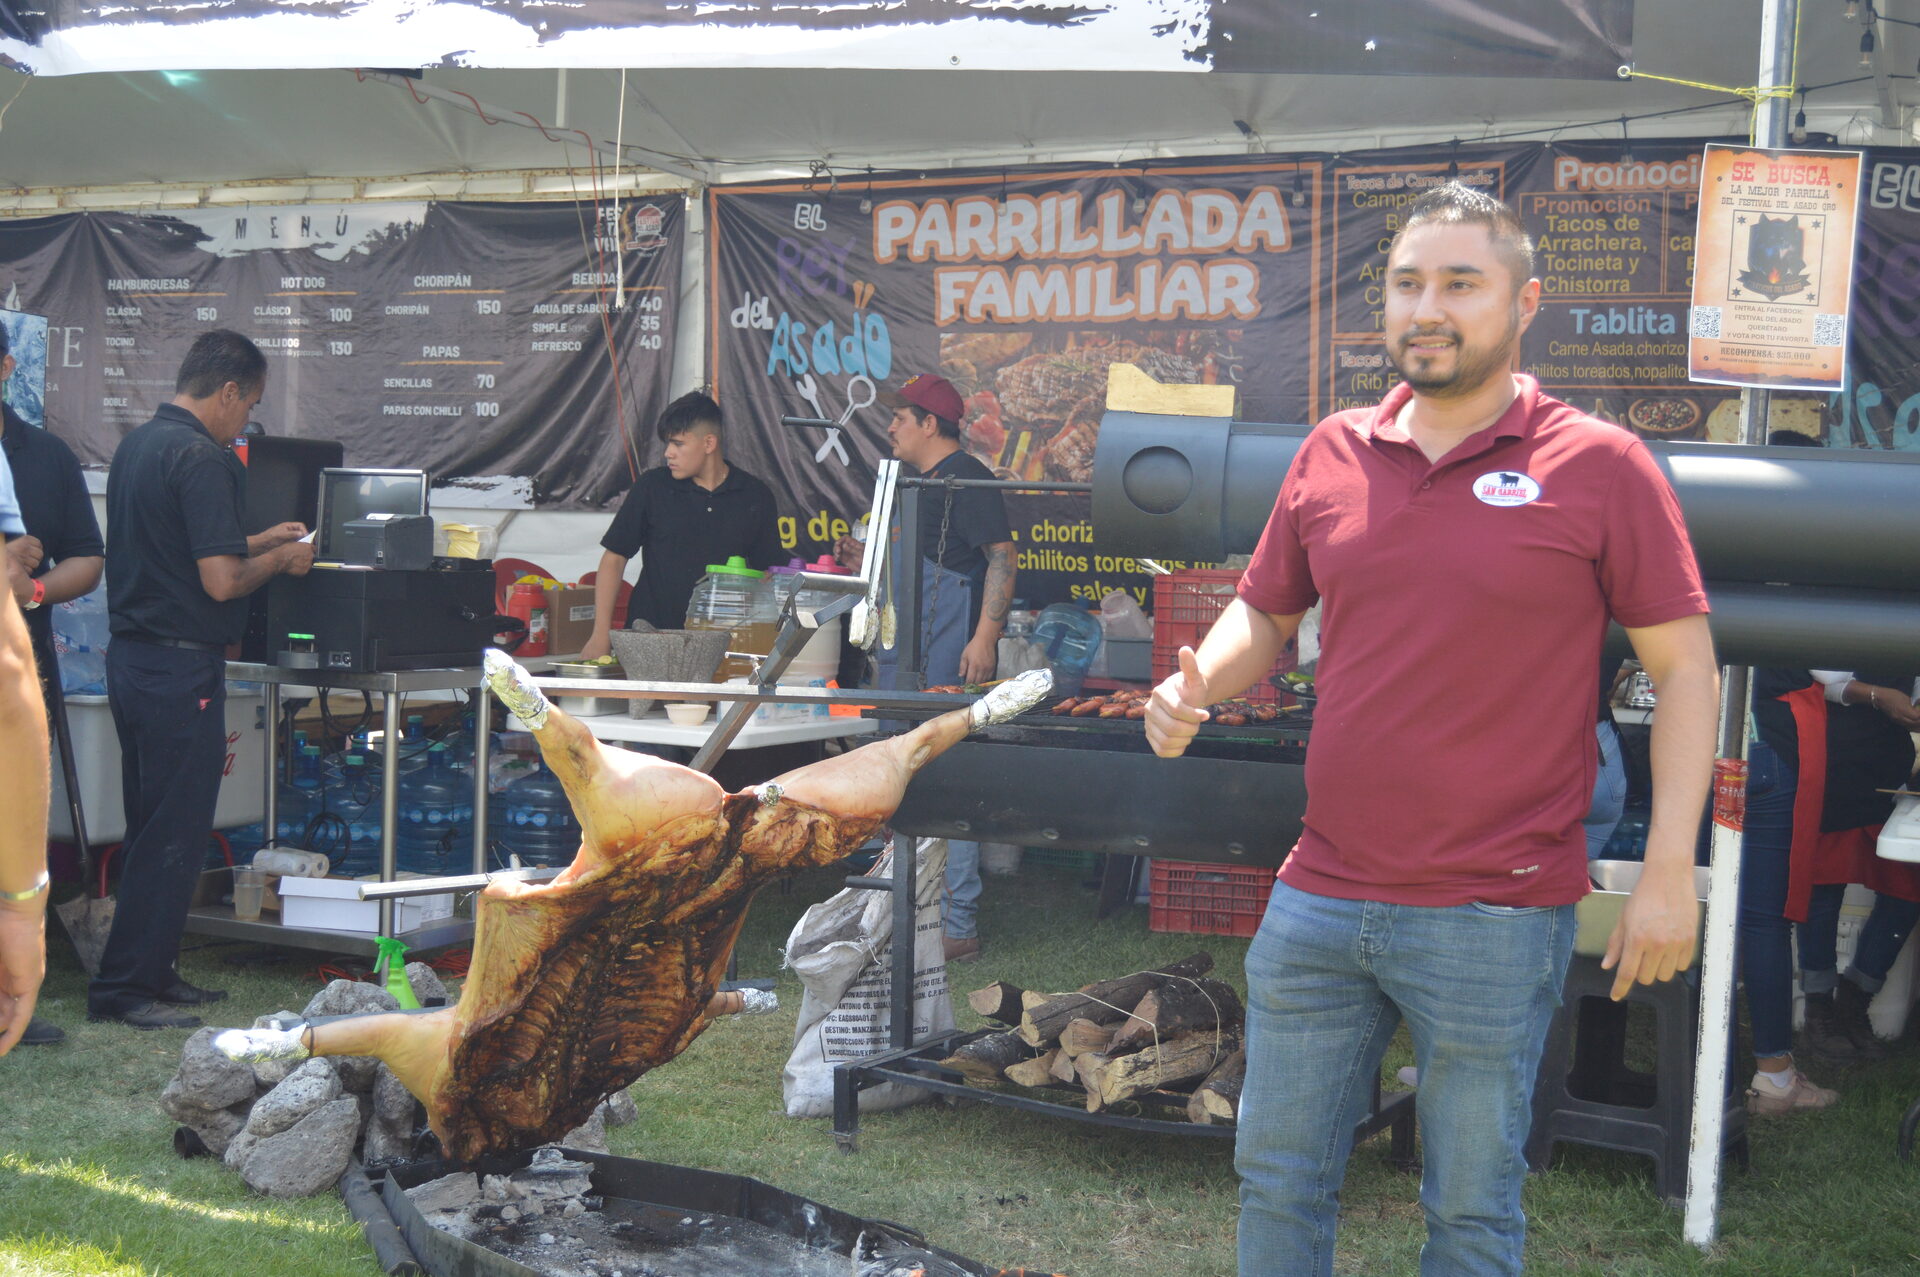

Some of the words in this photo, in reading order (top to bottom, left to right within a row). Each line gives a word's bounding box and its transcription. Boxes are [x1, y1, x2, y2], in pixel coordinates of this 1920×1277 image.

[1346, 175, 1386, 190] Tacos
[1387, 173, 1404, 188] de
[1406, 173, 1446, 188] Carne
[1732, 161, 1756, 182] SE
[1768, 164, 1831, 187] BUSCA
[1730, 185, 1742, 195] LA
[1748, 186, 1780, 197] MEJOR
[1785, 188, 1830, 200] PARRILLA
[1533, 194, 1651, 215] Promoción
[1721, 196, 1735, 206] DEL
[1738, 198, 1772, 208] FESTIVAL
[1776, 200, 1790, 209] DEL
[1793, 201, 1818, 210] ASADO
[794, 203, 827, 231] EL
[875, 188, 1289, 261] PARRILLADA
[1545, 214, 1608, 233] Tacos
[1614, 213, 1641, 232] de
[1536, 234, 1648, 253] Arrachera,
[1544, 253, 1624, 272] Tocineta
[1628, 257, 1640, 276] y
[107, 278, 191, 291] HAMBURGUESAS
[281, 277, 303, 289] HOT
[303, 277, 326, 289] DOG
[413, 272, 472, 287] CHORIPÁN
[1543, 275, 1631, 293] Chistorra
[936, 258, 1260, 325] FAMILIAR
[106, 305, 143, 316] CLÁSICA
[253, 304, 292, 316] CLÁSICO
[385, 304, 430, 315] CHORIPÁN
[532, 304, 561, 314] AGUA
[562, 304, 575, 314] DE
[576, 303, 611, 314] SABOR
[1734, 304, 1756, 312] ENTRA
[1569, 306, 1676, 335] Tablita
[1734, 314, 1764, 322] FESTIVAL
[532, 323, 567, 333] SIMPLE
[105, 337, 136, 347] TOCINO
[252, 338, 281, 348] CHILLI
[281, 338, 301, 348] DOG
[1732, 332, 1750, 340] VOTA
[1776, 335, 1809, 343] FAVORITA
[422, 345, 461, 358] PAPAS
[531, 341, 582, 351] REFRESCO
[1548, 341, 1589, 357] Carne
[1720, 347, 1775, 359] RECOMPENSA:
[1339, 350, 1384, 368] Tacos
[1525, 363, 1570, 379] chilitos
[383, 378, 432, 388] SENCILLAS
[1351, 372, 1383, 394] (Rib
[383, 405, 413, 416] PAPAS
[413, 406, 433, 416] CON
[433, 406, 462, 417] CHILLI
[807, 510, 849, 542] de
[1016, 549, 1089, 573] chilitos
[1133, 587, 1148, 607] y
